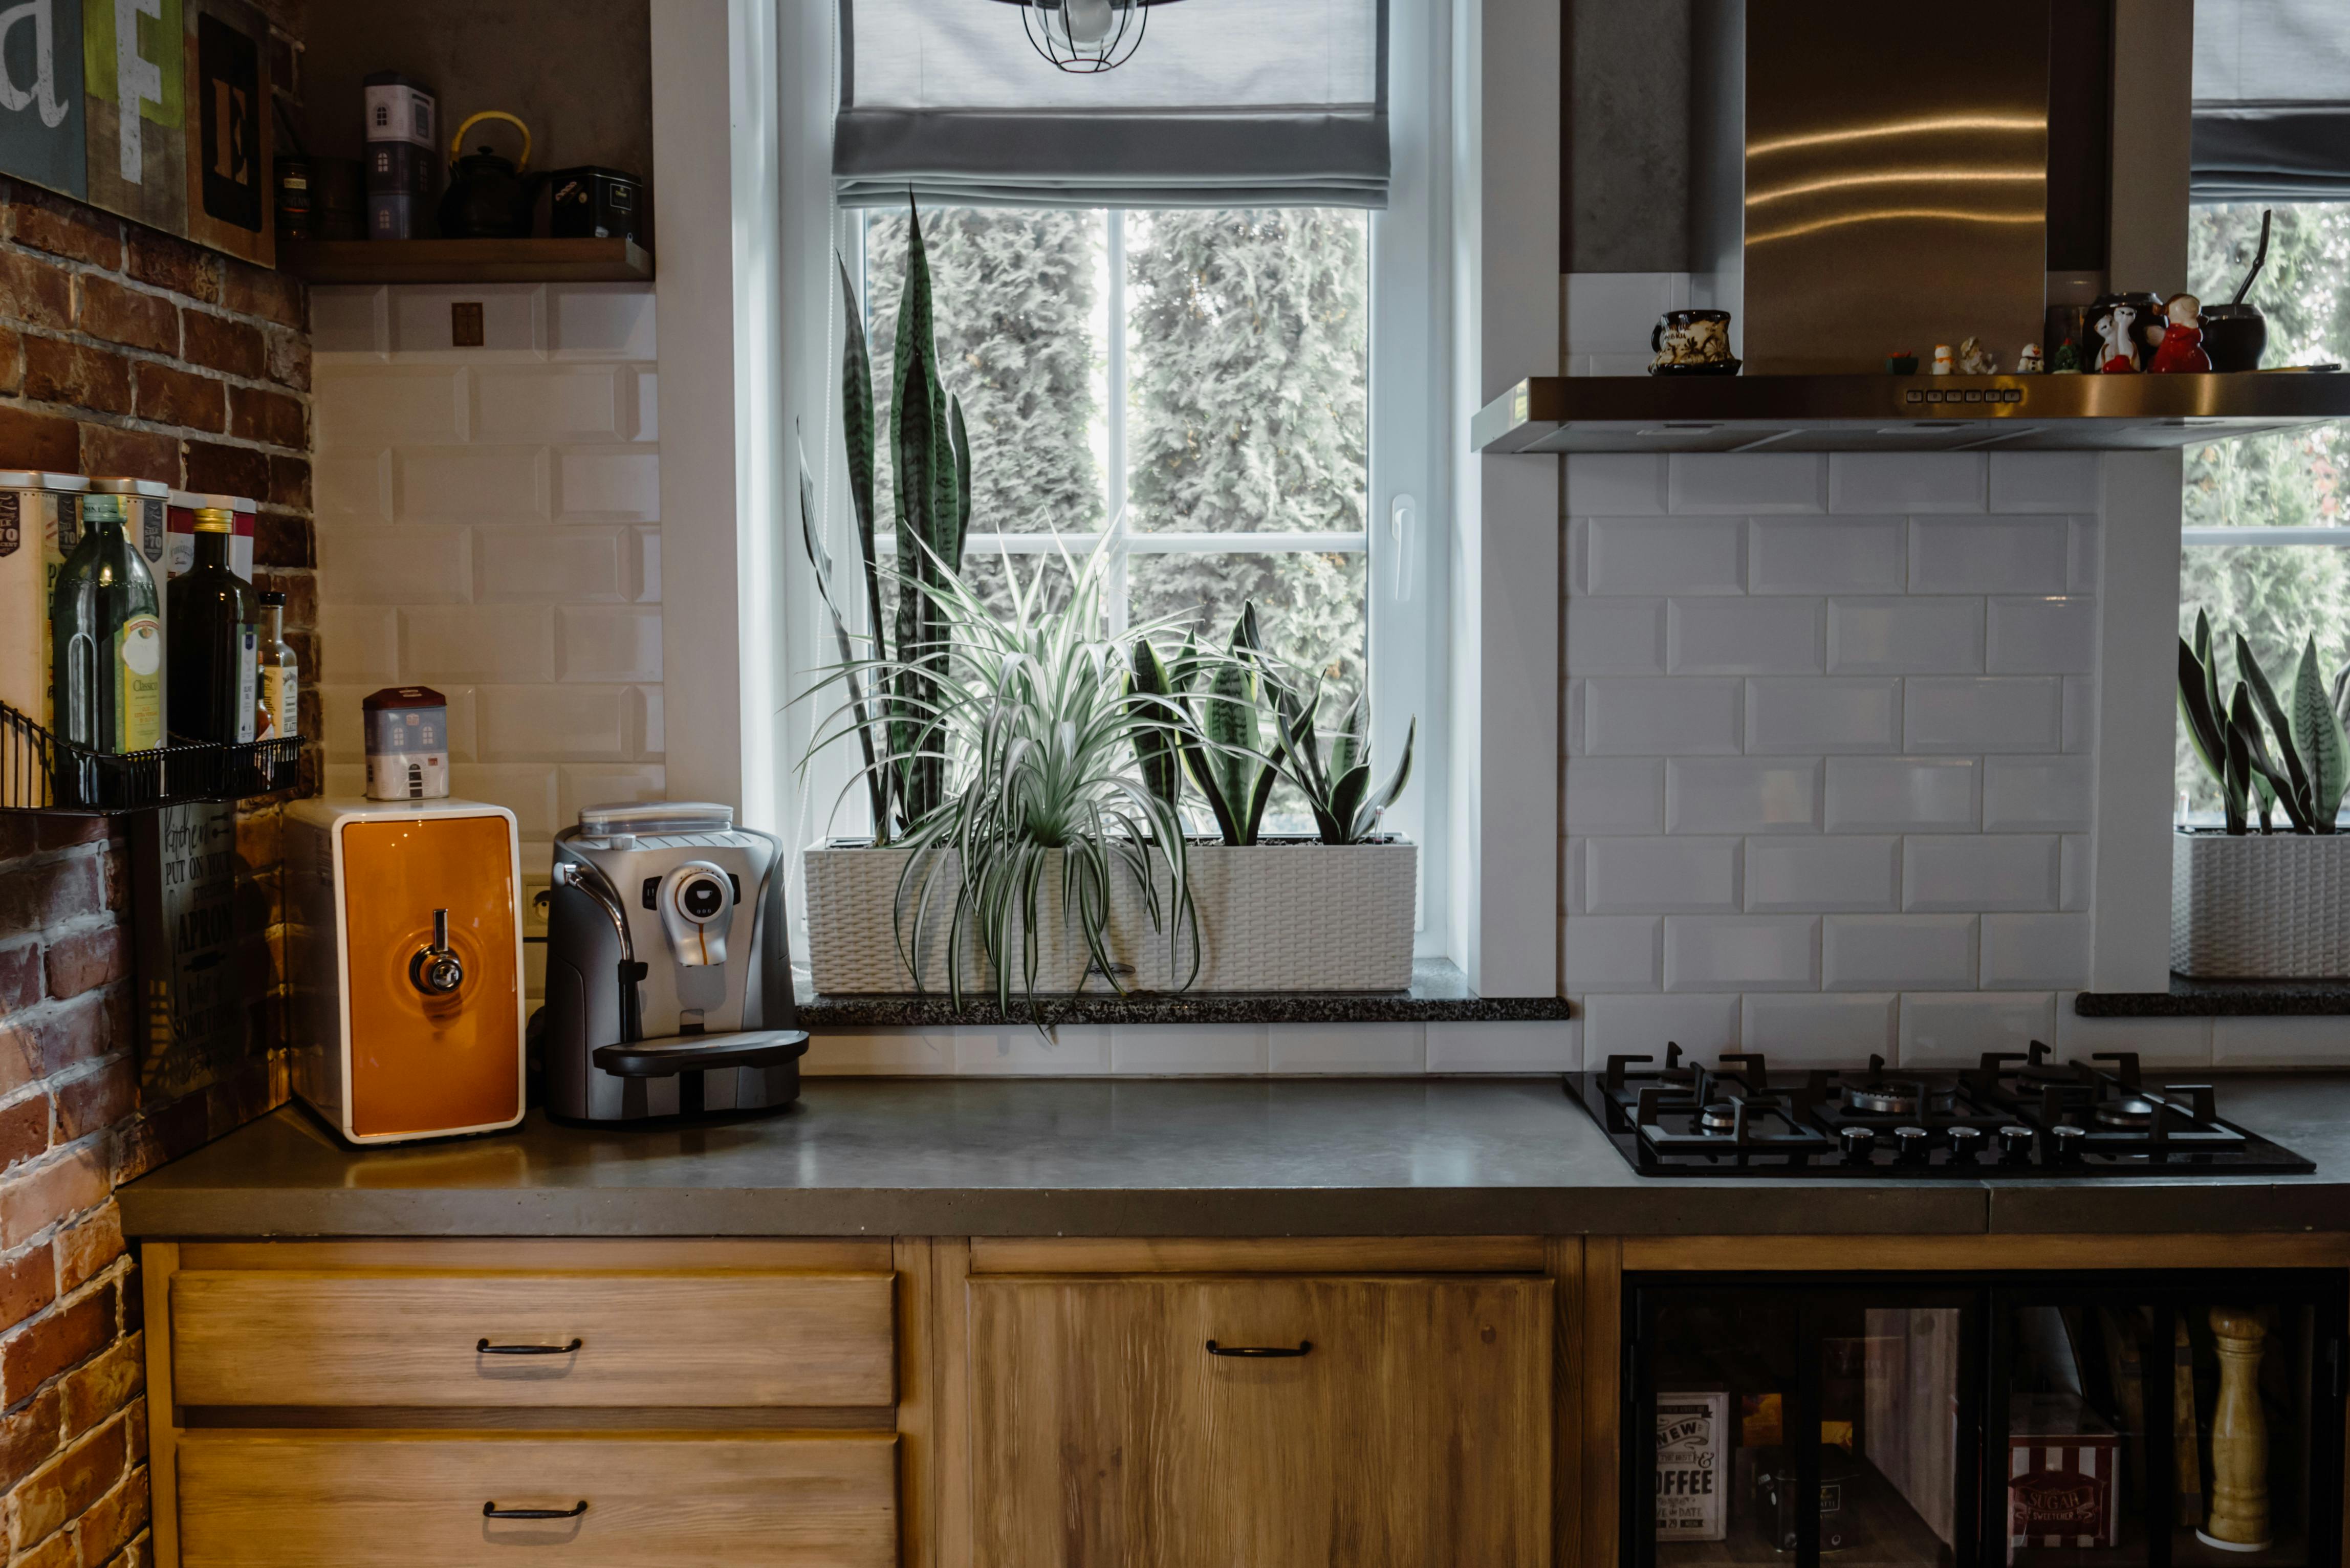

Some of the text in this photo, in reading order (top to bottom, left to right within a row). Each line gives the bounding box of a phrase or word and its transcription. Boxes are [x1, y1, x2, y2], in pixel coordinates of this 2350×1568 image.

[64, 531, 76, 545] 70
[149, 535, 162, 549] 70
[165, 804, 209, 860] kitchen
[165, 851, 231, 885] PUT ON YOUR
[178, 901, 233, 955] APRON
[1656, 1470, 1713, 1495] OFFEE
[2028, 1491, 2080, 1510] SUGAR
[1679, 1507, 1703, 1517] DATE
[1668, 1519, 1678, 1528] 29
